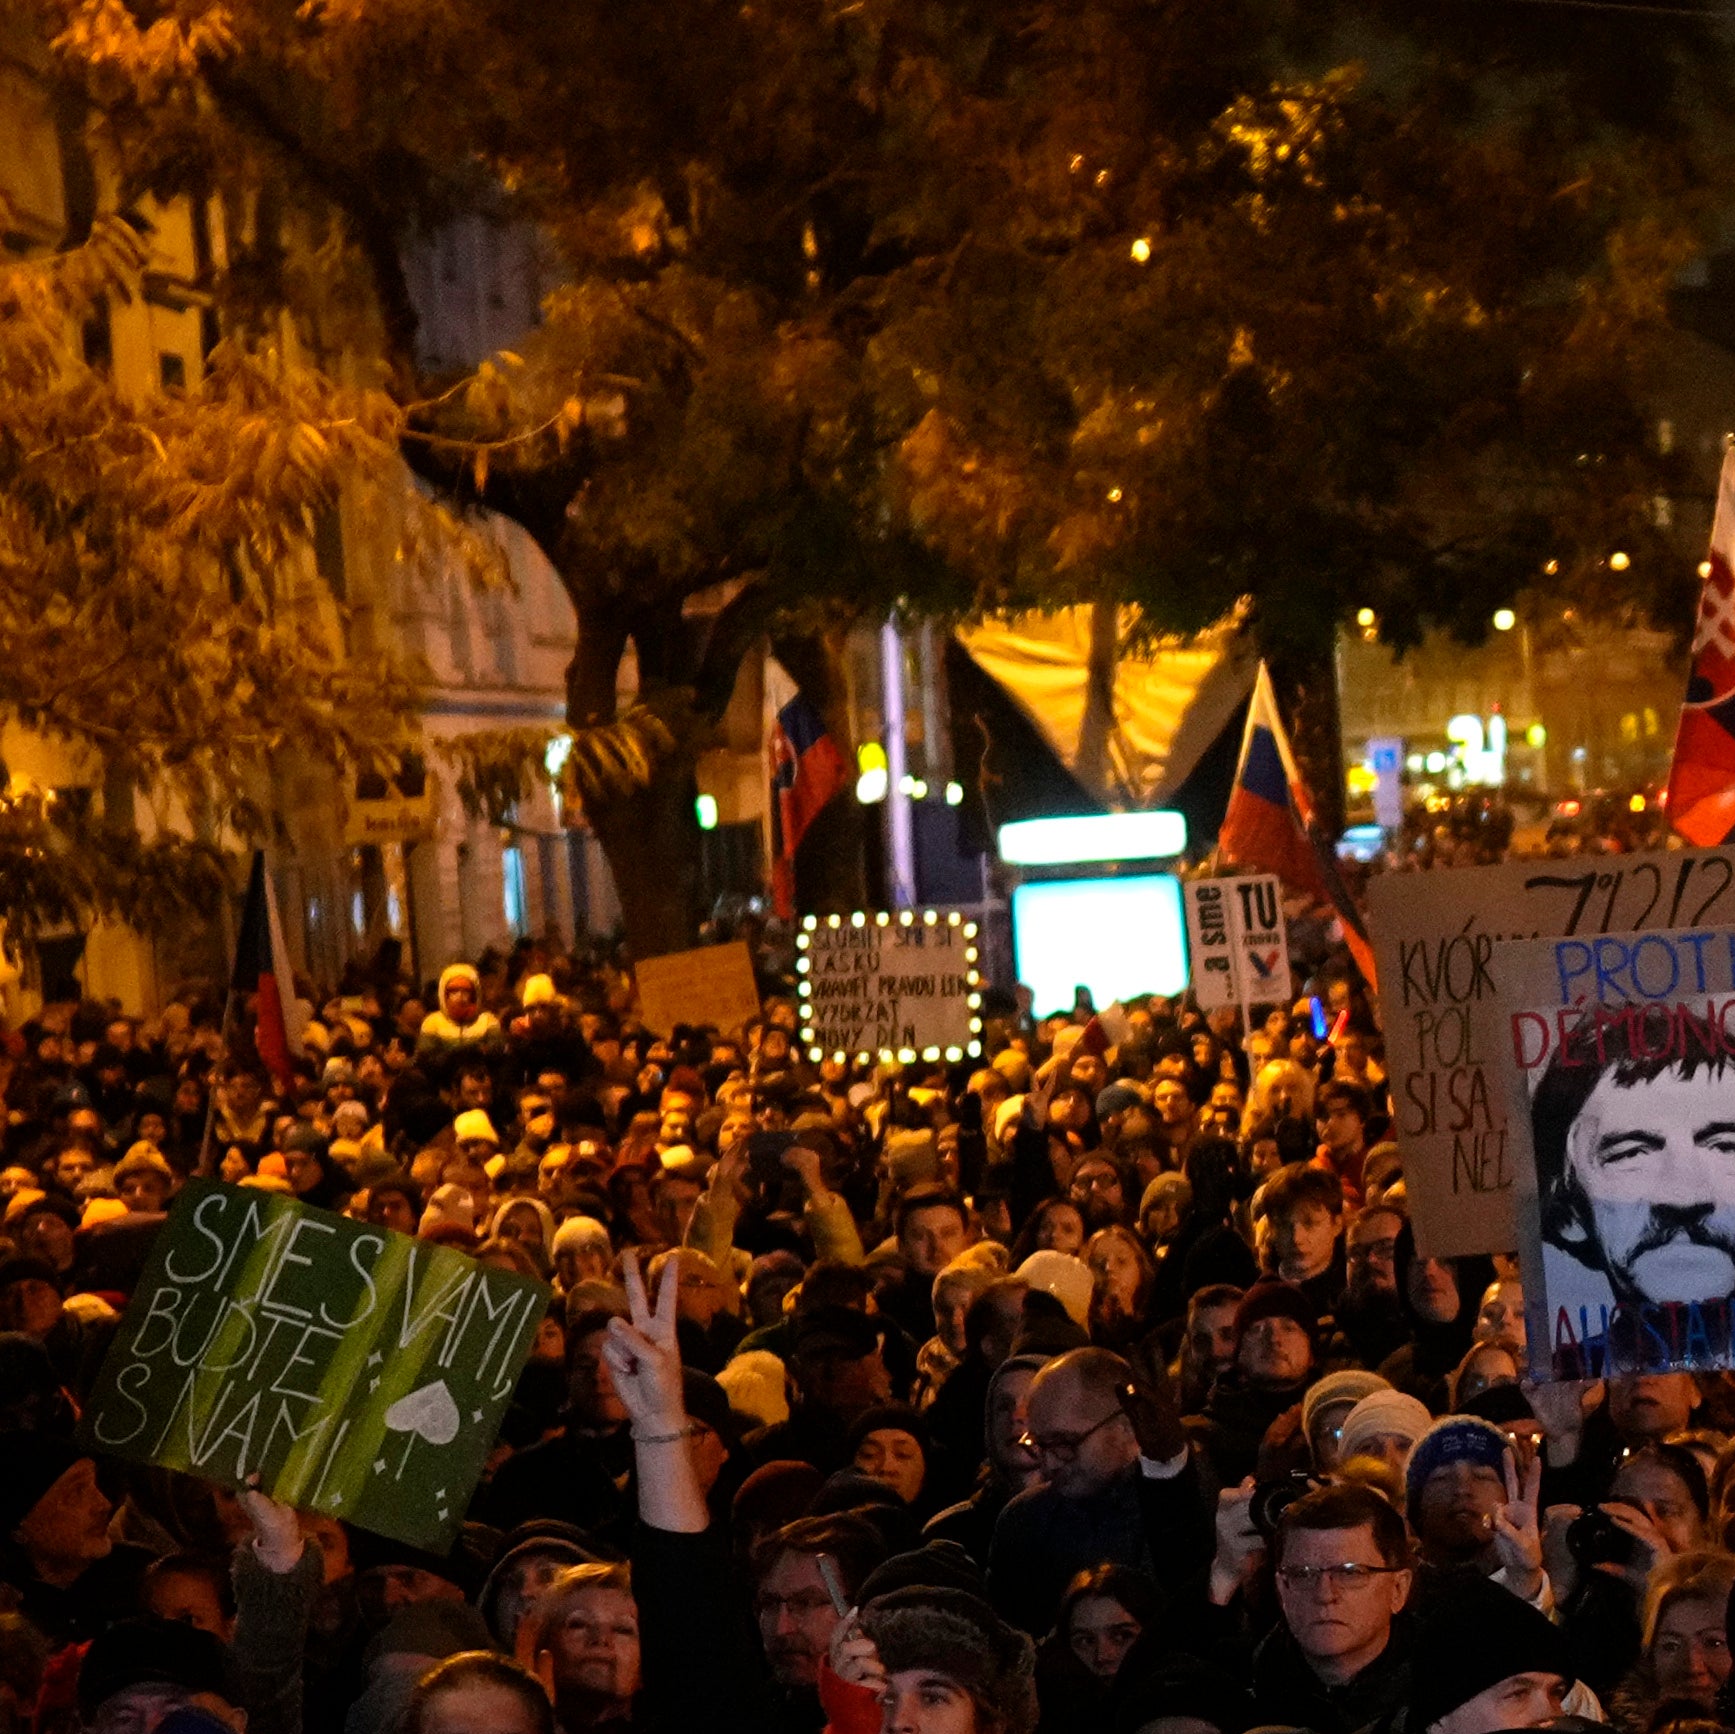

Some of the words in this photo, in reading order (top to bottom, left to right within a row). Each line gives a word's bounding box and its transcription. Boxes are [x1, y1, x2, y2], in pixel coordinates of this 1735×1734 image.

[1237, 881, 1278, 931] TU
[1399, 914, 1515, 1006] KVÓR
[163, 1192, 336, 1320] SME
[318, 1234, 387, 1330] S
[94, 1363, 149, 1446] S
[152, 1367, 351, 1507] NAMI
